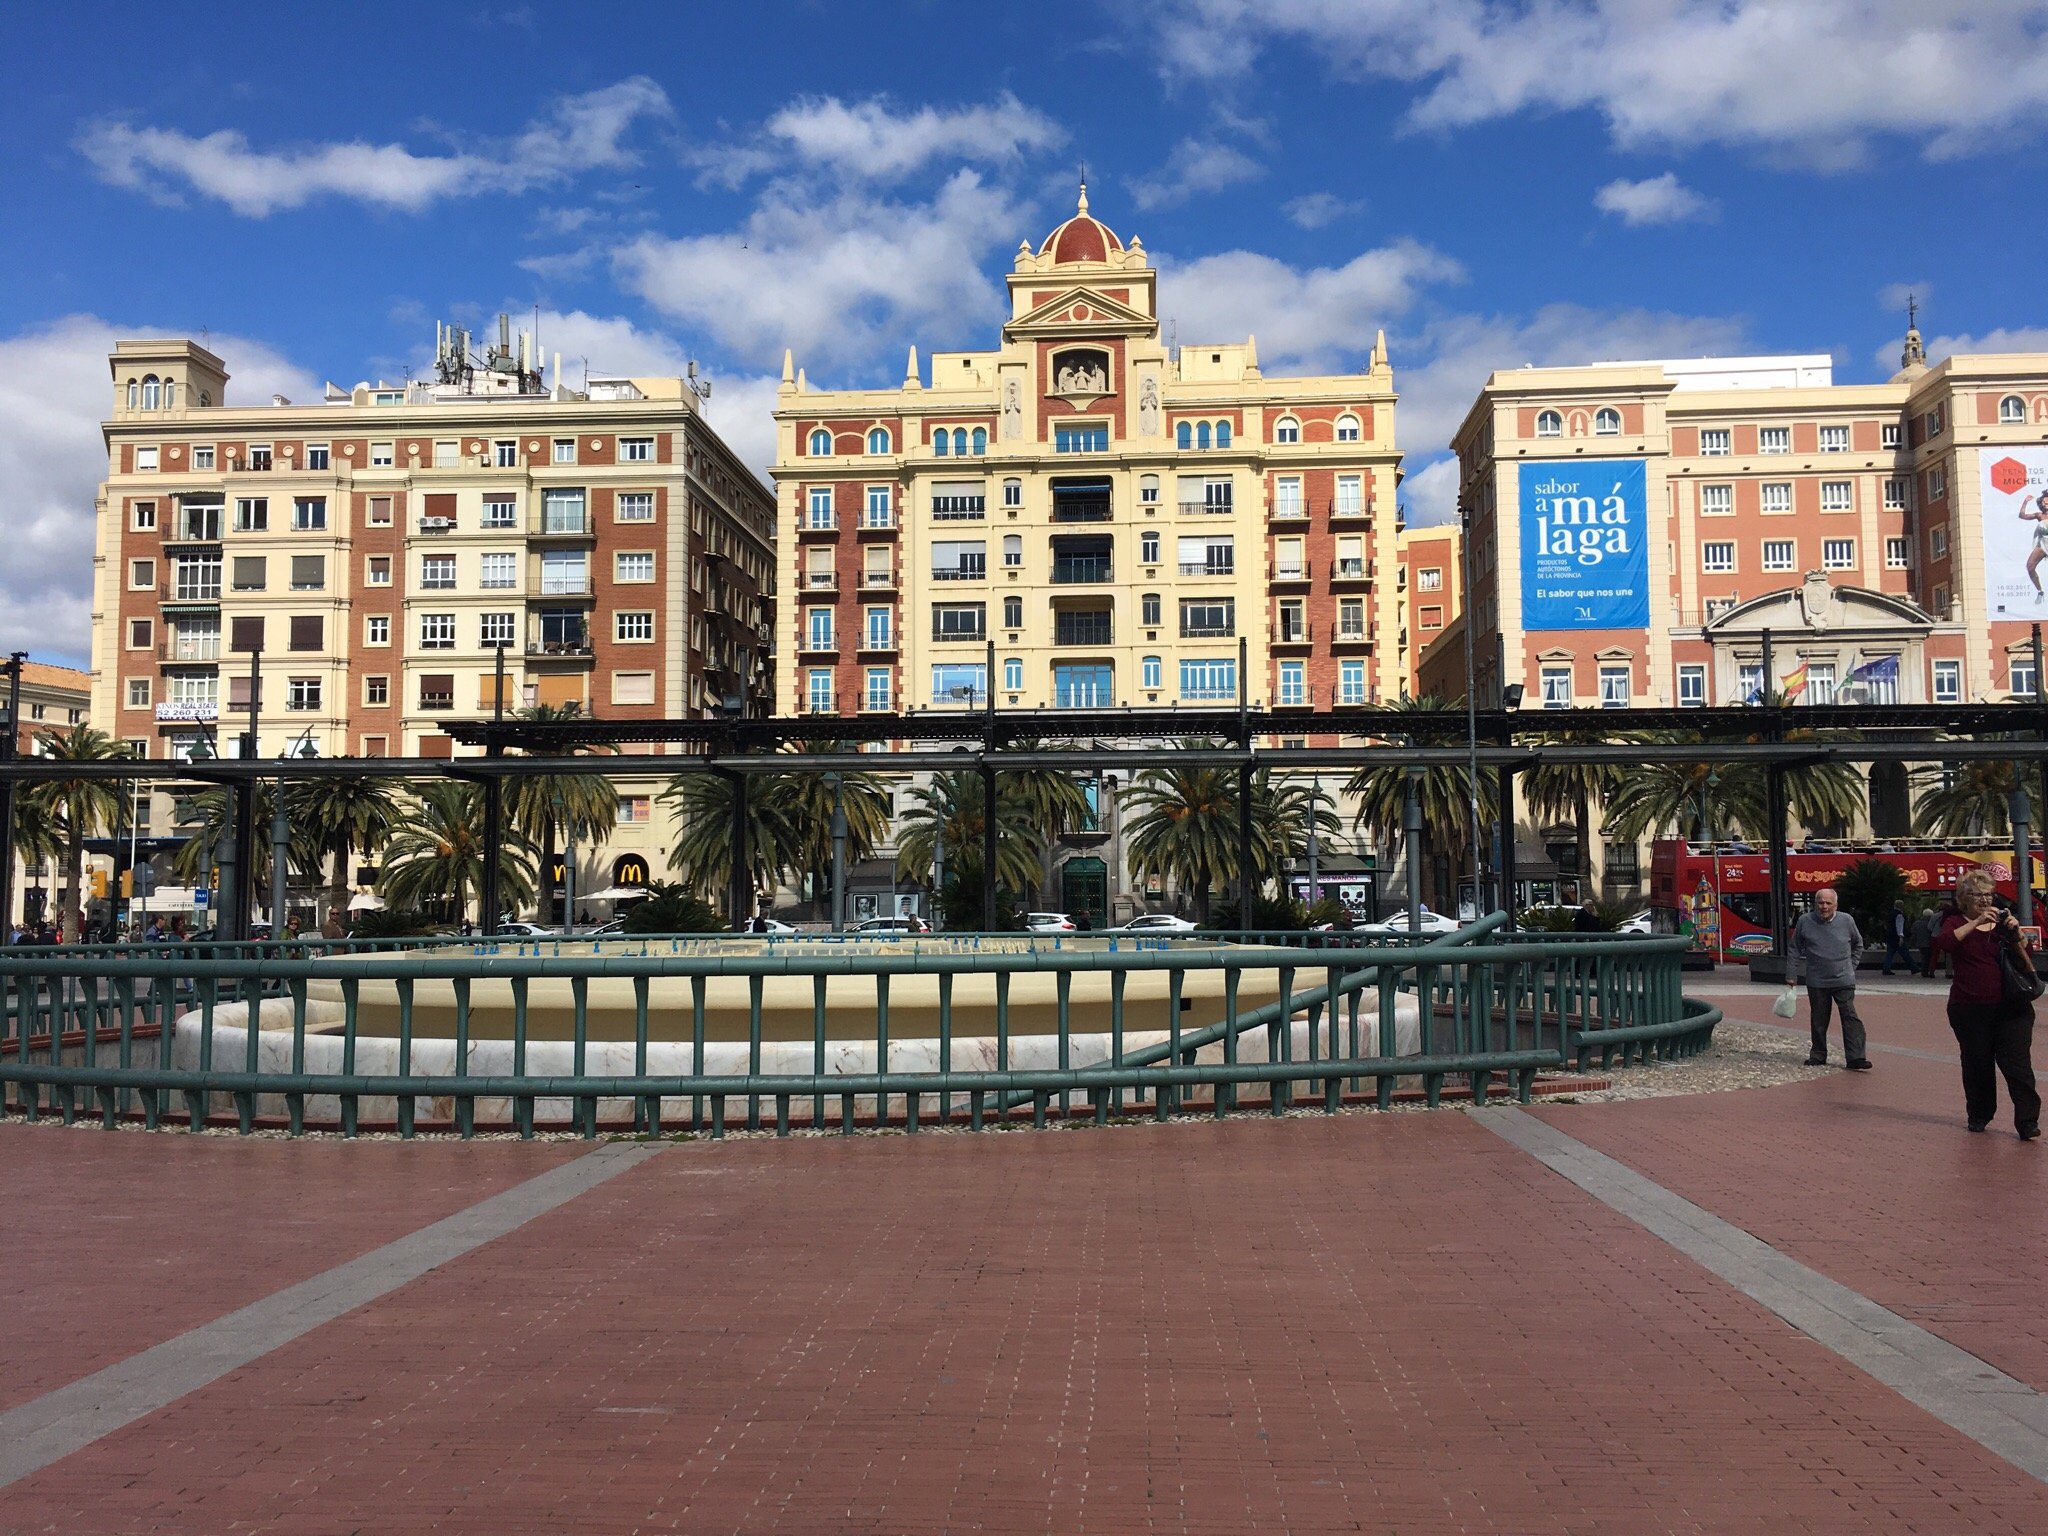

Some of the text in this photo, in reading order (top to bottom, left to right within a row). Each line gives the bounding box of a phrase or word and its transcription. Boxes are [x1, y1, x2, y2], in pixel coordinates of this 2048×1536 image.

[1535, 478, 1580, 495] sabor
[2003, 477, 2043, 485] MICHEL
[1536, 497, 1549, 512] a
[1536, 516, 1631, 565] laga
[1537, 588, 1633, 599] El sabor que nos une
